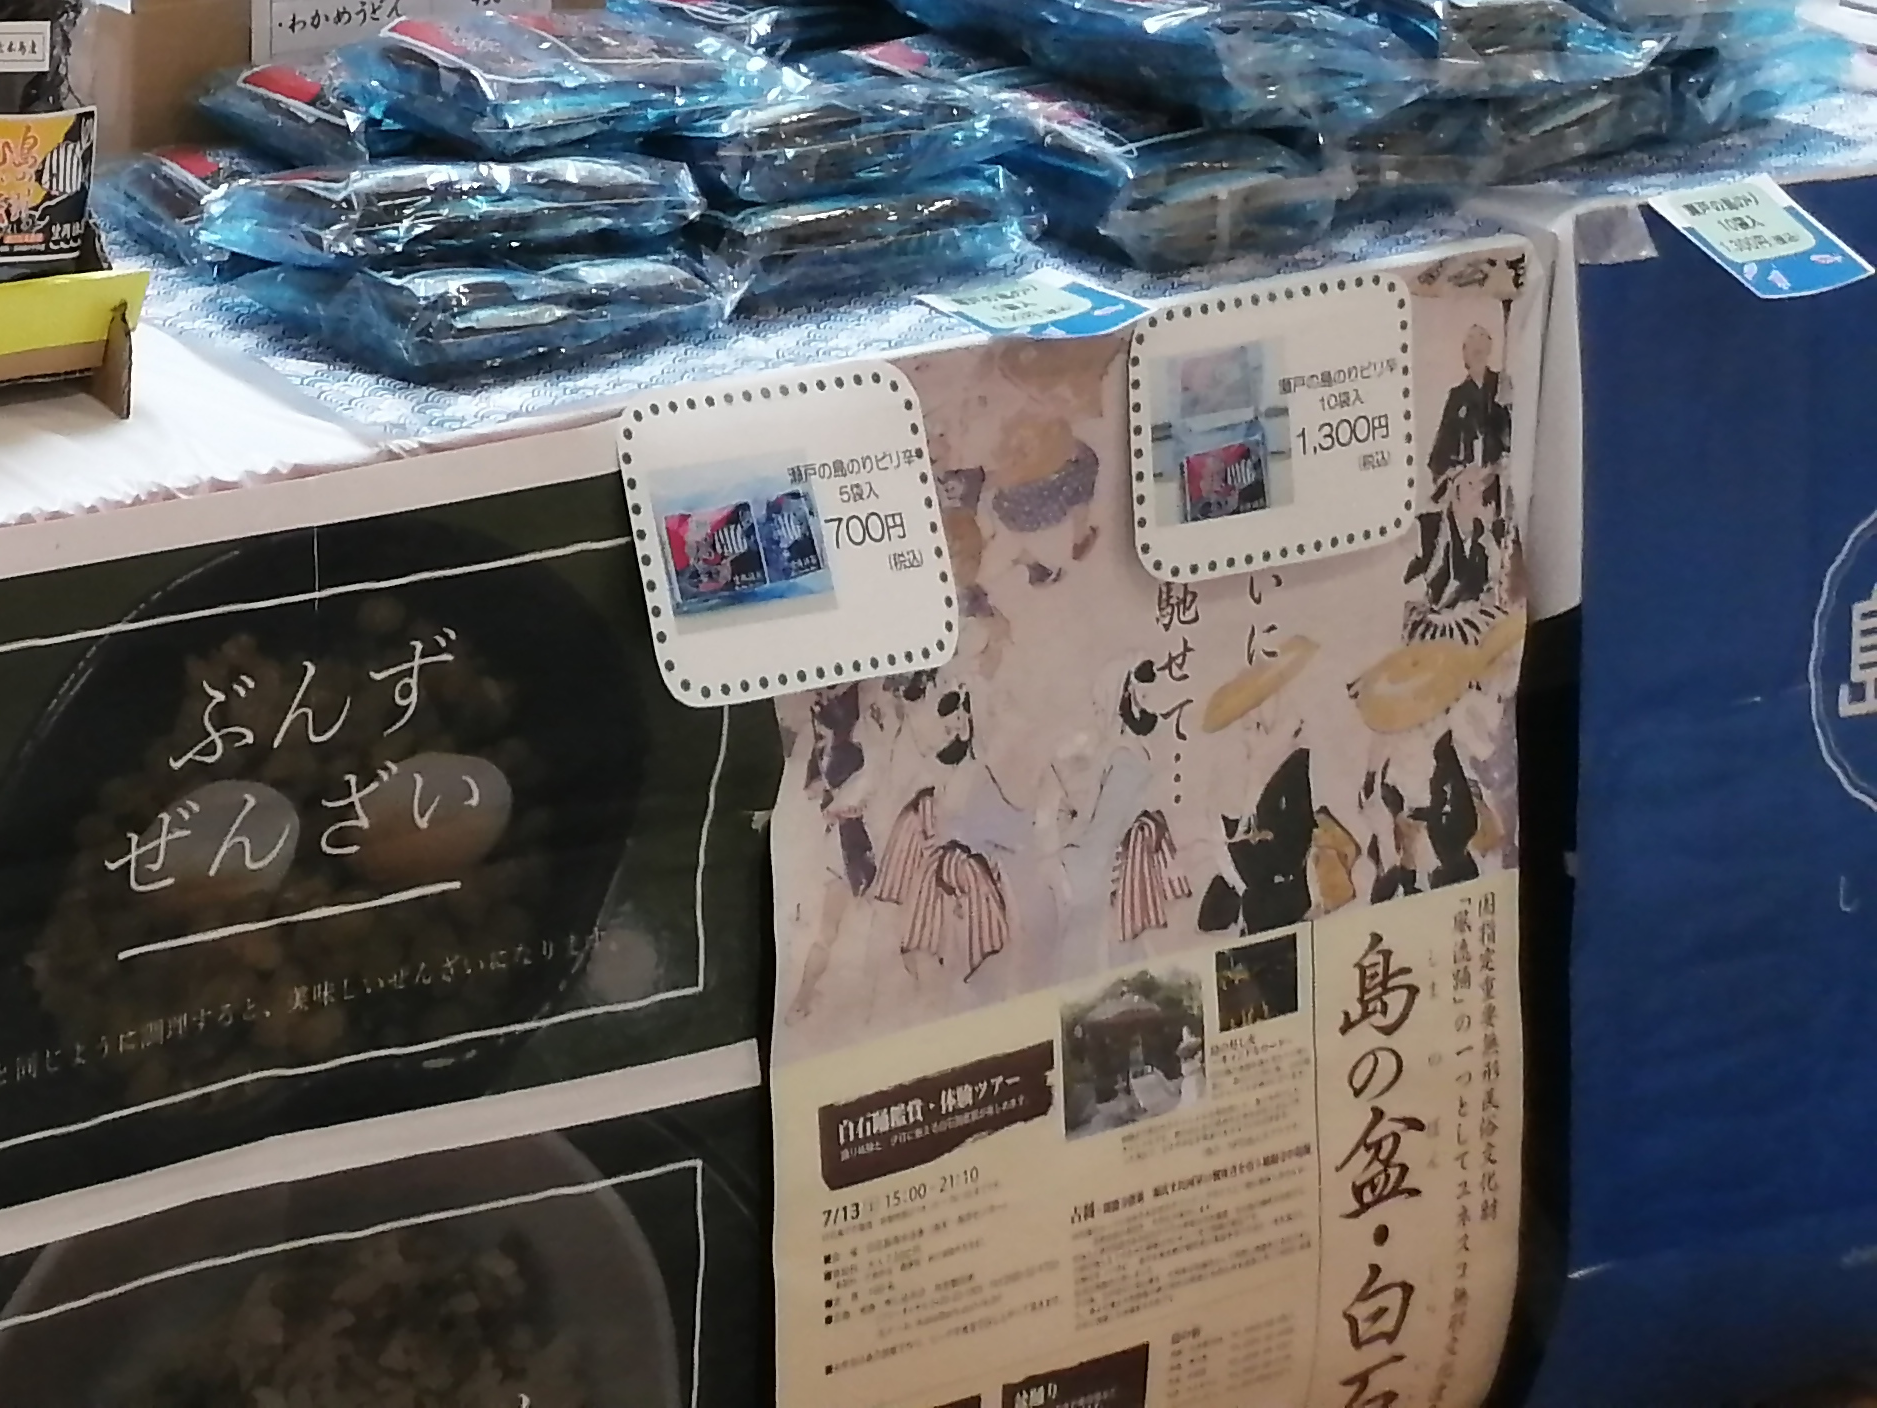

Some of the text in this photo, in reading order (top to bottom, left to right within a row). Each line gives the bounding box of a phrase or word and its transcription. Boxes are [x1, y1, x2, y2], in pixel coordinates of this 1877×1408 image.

[1297, 414, 1390, 456] 1,300円
[787, 448, 916, 485] 瀬戸の島のりピリ辛
[838, 482, 879, 503] 5袋入
[824, 511, 906, 549] 700円
[167, 626, 456, 773] ぶんず
[104, 758, 482, 897] ぜんざい
